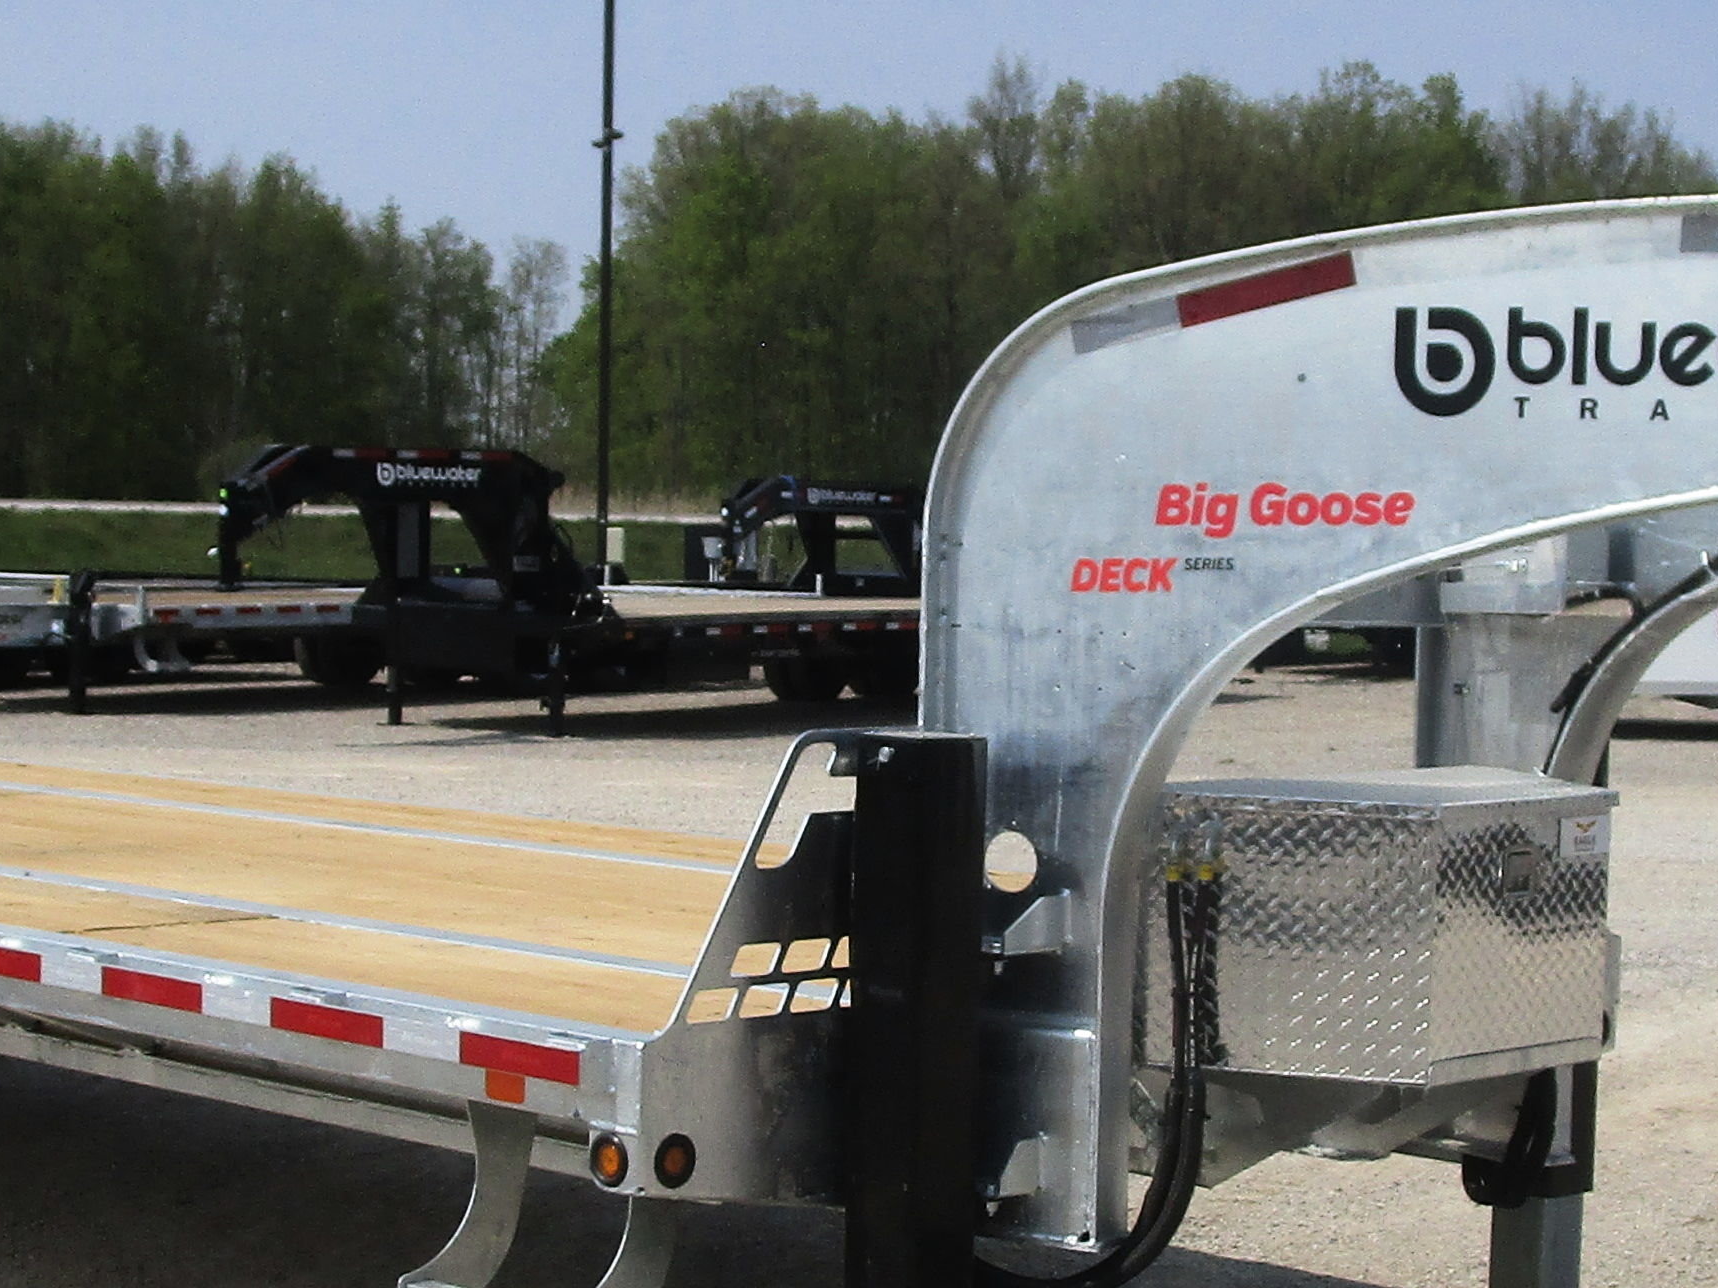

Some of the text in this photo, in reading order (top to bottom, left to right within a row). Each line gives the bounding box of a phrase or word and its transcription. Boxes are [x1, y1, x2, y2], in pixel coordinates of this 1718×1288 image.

[396, 464, 482, 481] bluewater
[1155, 482, 1416, 539] Big Goose
[1070, 557, 1234, 593] DECK SERIES
